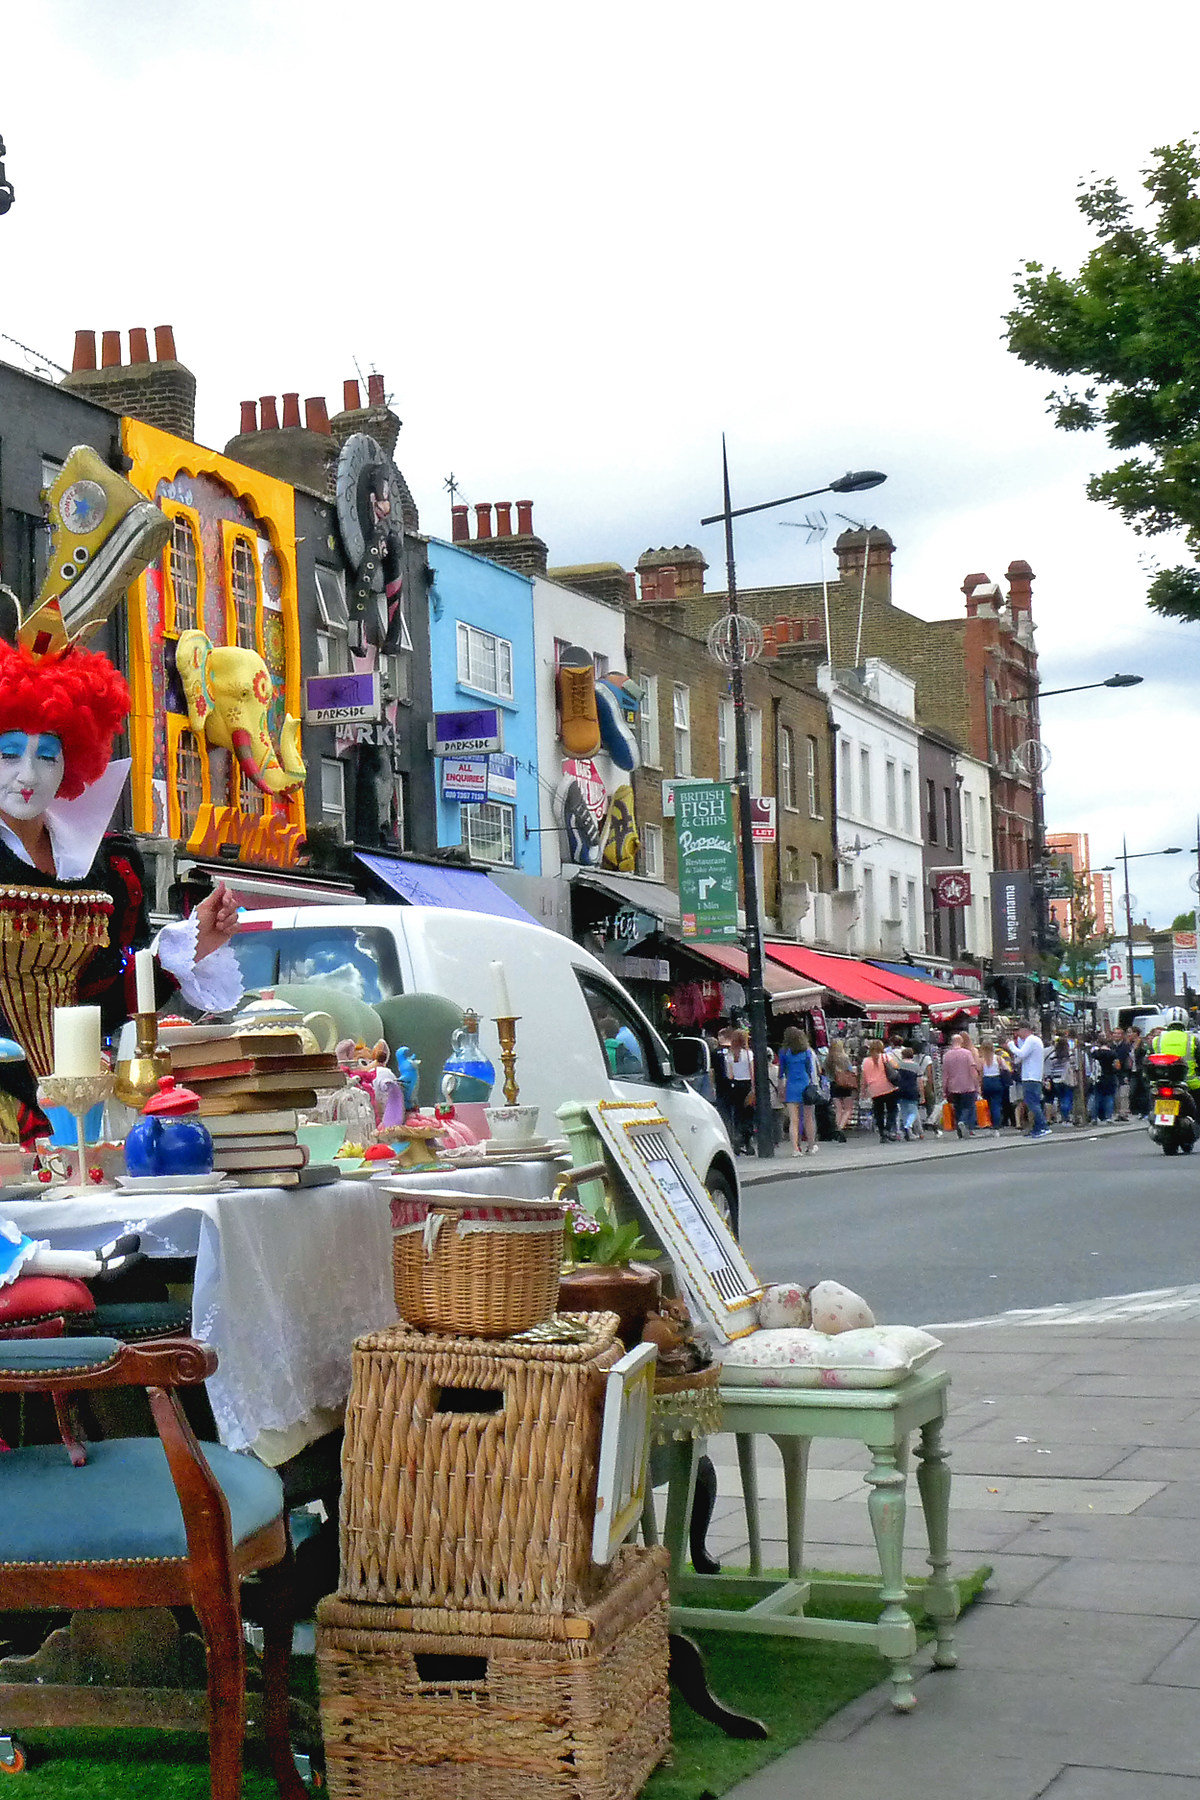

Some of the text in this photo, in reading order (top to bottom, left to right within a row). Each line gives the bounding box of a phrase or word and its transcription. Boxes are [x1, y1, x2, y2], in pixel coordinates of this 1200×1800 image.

[458, 764, 472, 772] ALL
[446, 773, 485, 783] ENQUIRIES
[680, 790, 725, 802] BRITISH
[681, 800, 726, 818] FISH
[681, 816, 727, 828] & CHIPS
[679, 830, 732, 857] Poppies
[685, 857, 727, 866] Restaurant
[1005, 884, 1019, 941] wagamama
[1160, 1114, 1169, 1122] L
